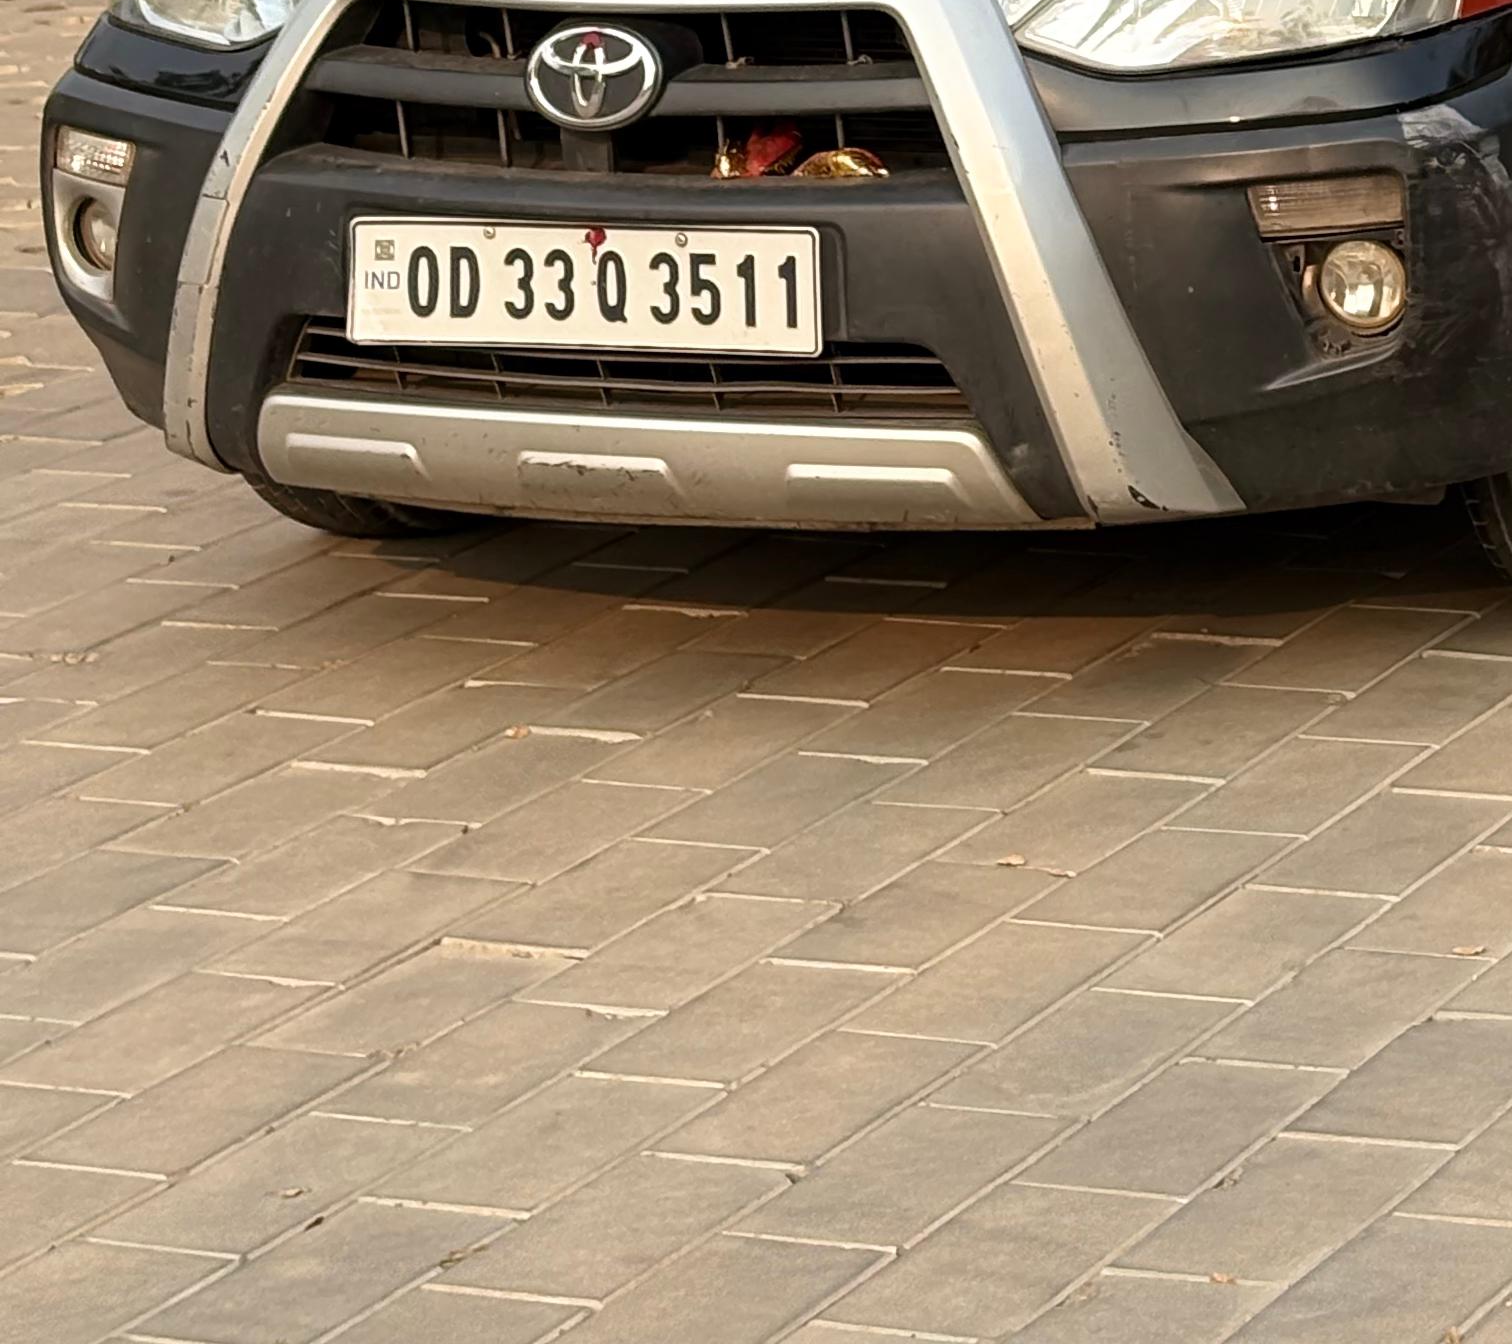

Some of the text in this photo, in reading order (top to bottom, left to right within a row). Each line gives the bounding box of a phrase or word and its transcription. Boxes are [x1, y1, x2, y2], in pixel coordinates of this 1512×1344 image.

[364, 269, 401, 291] IND
[407, 245, 799, 329] OD 33 Q 3511
